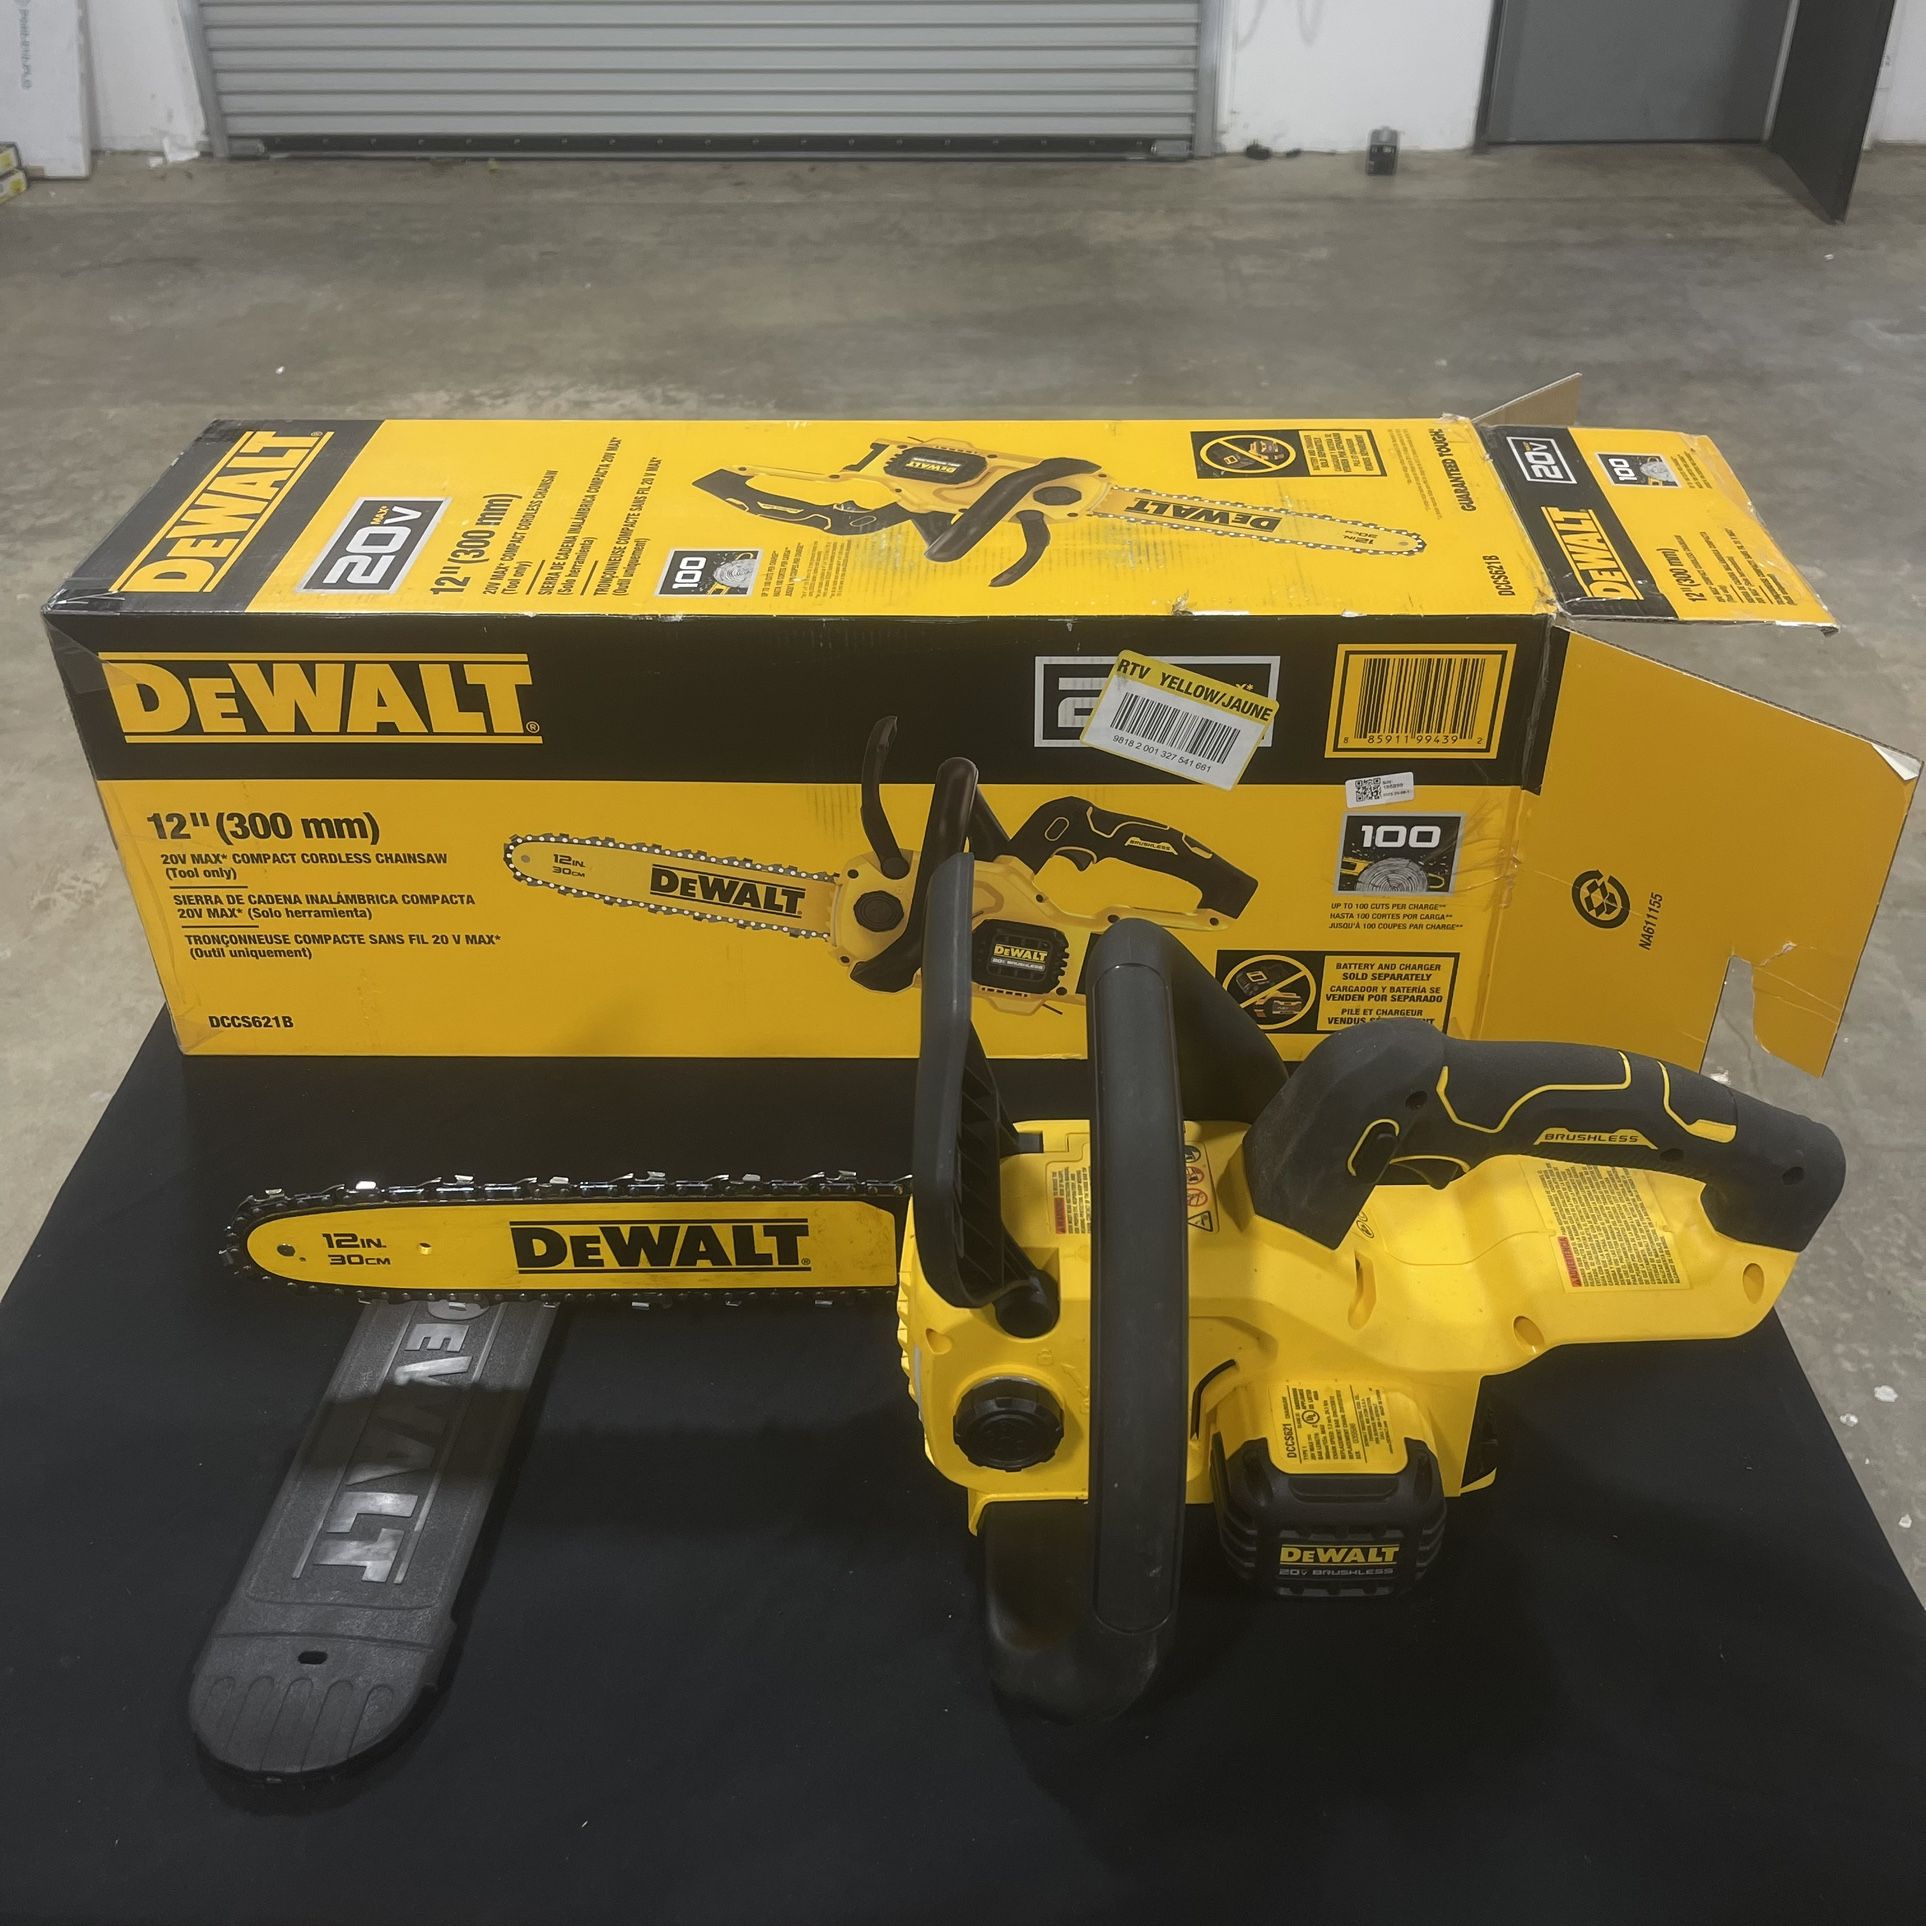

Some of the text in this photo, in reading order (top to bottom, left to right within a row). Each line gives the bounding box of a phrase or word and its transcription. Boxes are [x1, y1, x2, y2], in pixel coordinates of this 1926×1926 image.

[1524, 442, 1563, 479] 20V
[1608, 458, 1638, 481] 100
[1442, 458, 1477, 512] GUARANTEED
[120, 431, 321, 592] DEWALT
[475, 493, 523, 526] mm)
[1126, 498, 1281, 531] DEWALT
[500, 532, 527, 561] COMPACT
[516, 499, 543, 530] CORDLESS
[322, 506, 422, 584] 20V
[555, 534, 579, 560] CADENA
[1546, 507, 1638, 600] DEWALT
[550, 561, 566, 571] DE
[672, 556, 707, 589] 100
[1482, 555, 1516, 596] DCCS621B
[538, 571, 562, 595] SIERRA
[101, 662, 533, 733] DEWALT
[1116, 658, 1273, 722] RTV YELLOW/JAUNE
[1112, 734, 1134, 748] 9818
[1135, 741, 1143, 751] 2
[1142, 744, 1159, 756] 001
[1160, 749, 1177, 762] 327
[1177, 755, 1194, 767] 541
[1343, 735, 1483, 744] 8 85911 99439 2
[216, 812, 293, 846] (300
[301, 812, 380, 846] mm)
[1361, 825, 1441, 848] 100
[160, 853, 187, 865] 20V
[232, 853, 297, 864] COMPACT
[301, 852, 372, 864] CORDLESS
[375, 852, 448, 864] CHAINSAW
[165, 867, 237, 881] (Tool only)
[173, 891, 476, 905] SIERRA DE CADENA INALÁMBRICA COMPACTA
[650, 866, 806, 915] DEWALT
[177, 908, 203, 919] 20V
[248, 907, 282, 921] (Solo
[286, 907, 373, 921] herramienta)
[1638, 892, 1663, 951] NA611155
[184, 934, 291, 948] TRONÇONNEUSE
[294, 934, 366, 945] COMPACTE
[369, 934, 405, 945] SANS
[408, 934, 429, 945] FIL
[431, 934, 449, 945] 20
[452, 934, 461, 945] V
[190, 947, 313, 960] (Outil uniquement)
[994, 945, 1048, 961] DEWALT
[1336, 962, 1441, 972] BATTERY AND CHARGER
[1342, 972, 1432, 981] SOLD SEPARATELY
[1325, 993, 1443, 1003] VENDEN POR SEPARADO
[1329, 984, 1441, 994] CARGADOR Y BATERÍA SE
[208, 1015, 294, 1028] DCCS621B
[1327, 1017, 1366, 1025] VENDUS
[1341, 1008, 1424, 1017] PILE ET CHARGEUR
[1544, 1133, 1639, 1143] BRUSHLESS
[510, 1224, 809, 1268] DEWALT
[328, 1254, 391, 1266] 30CM
[1282, 1423, 1297, 1459] DCCS621
[1279, 1547, 1399, 1563] DEWALT
[1312, 1568, 1394, 1576] BRUSHLESS
